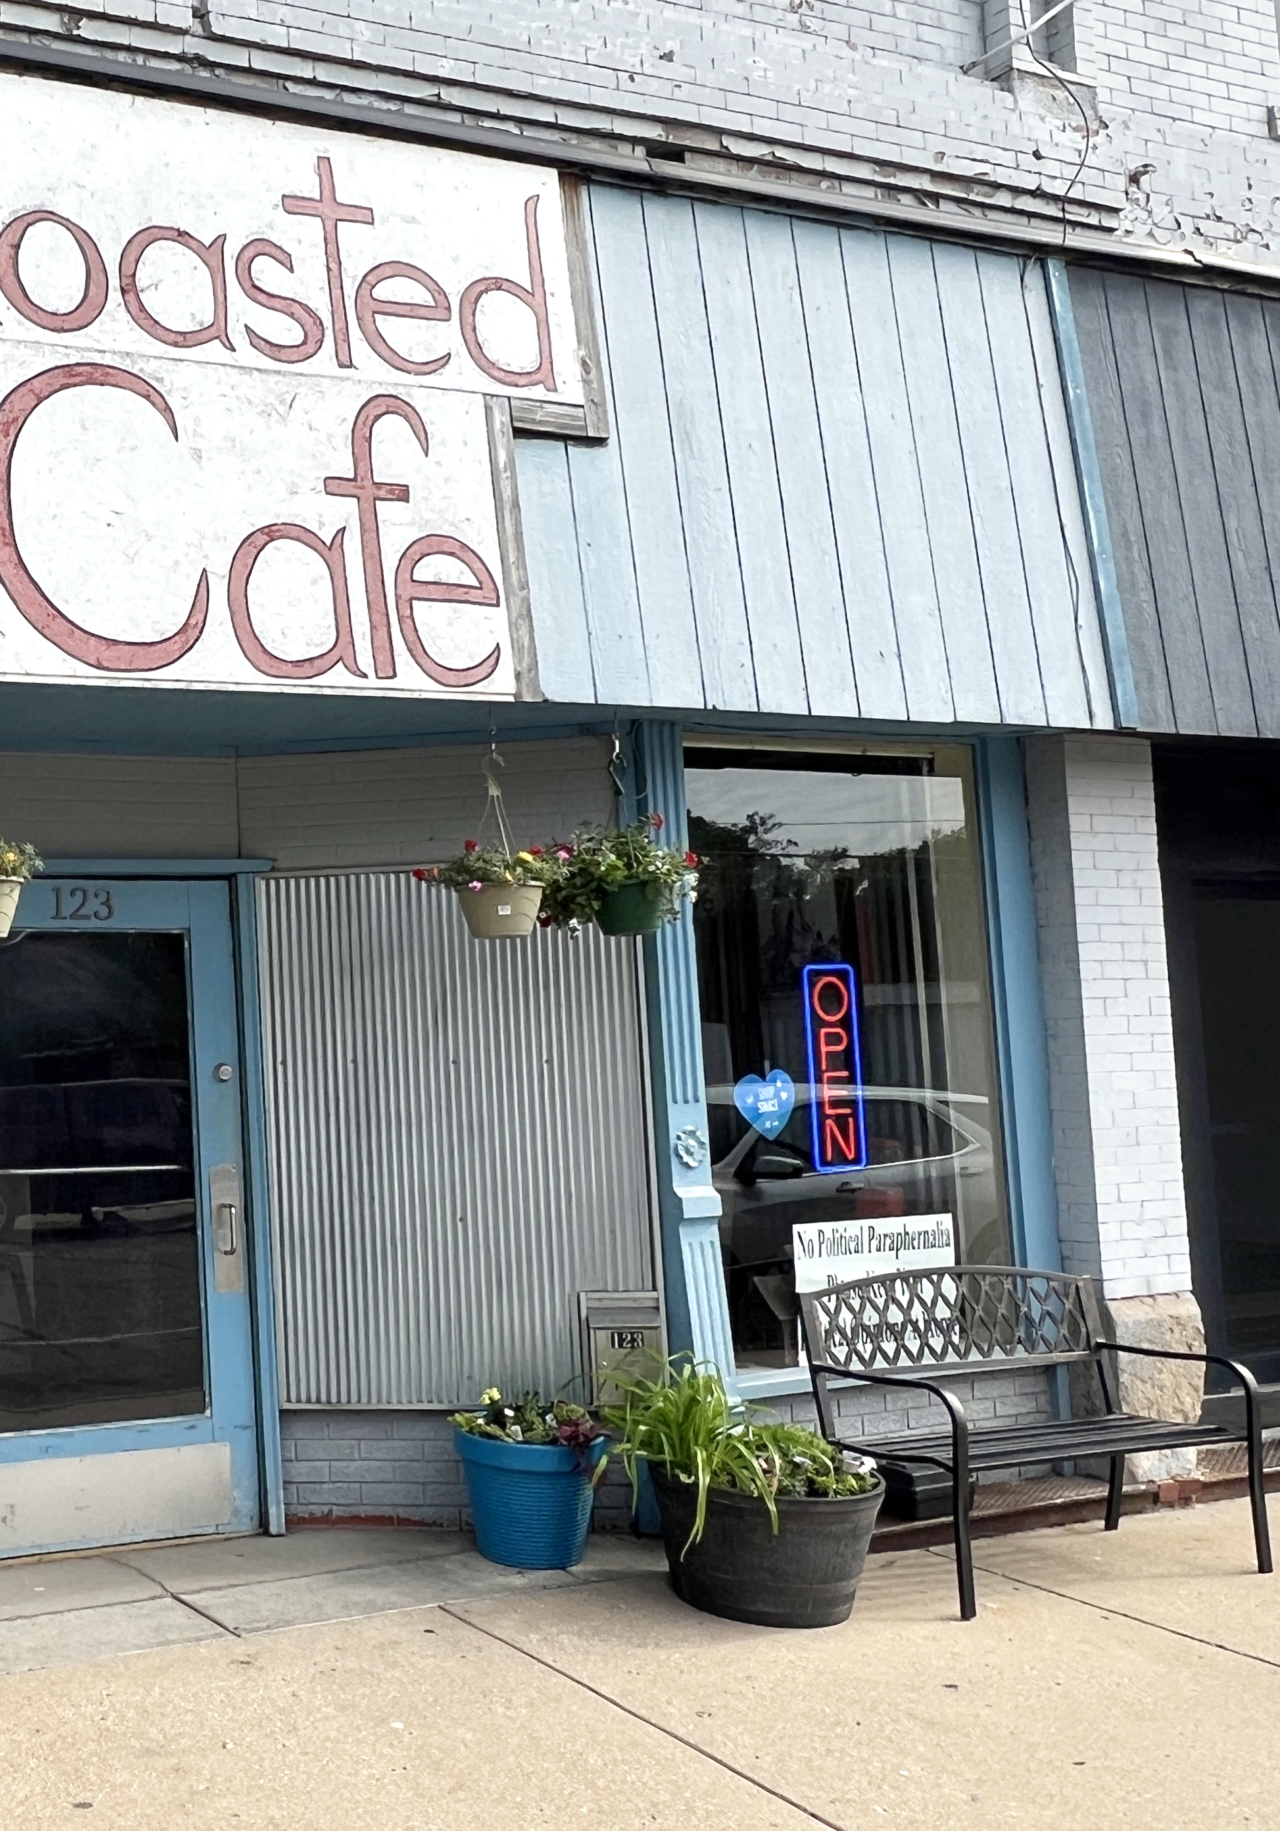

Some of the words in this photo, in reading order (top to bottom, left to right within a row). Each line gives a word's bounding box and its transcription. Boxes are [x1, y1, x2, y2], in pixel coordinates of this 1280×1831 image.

[50, 885, 114, 921] 123
[813, 976, 855, 1162] OPEN
[797, 1230, 814, 1260] No
[818, 1226, 864, 1258] Political
[868, 1220, 951, 1260] Paraphernalia
[613, 1332, 643, 1349] 123
